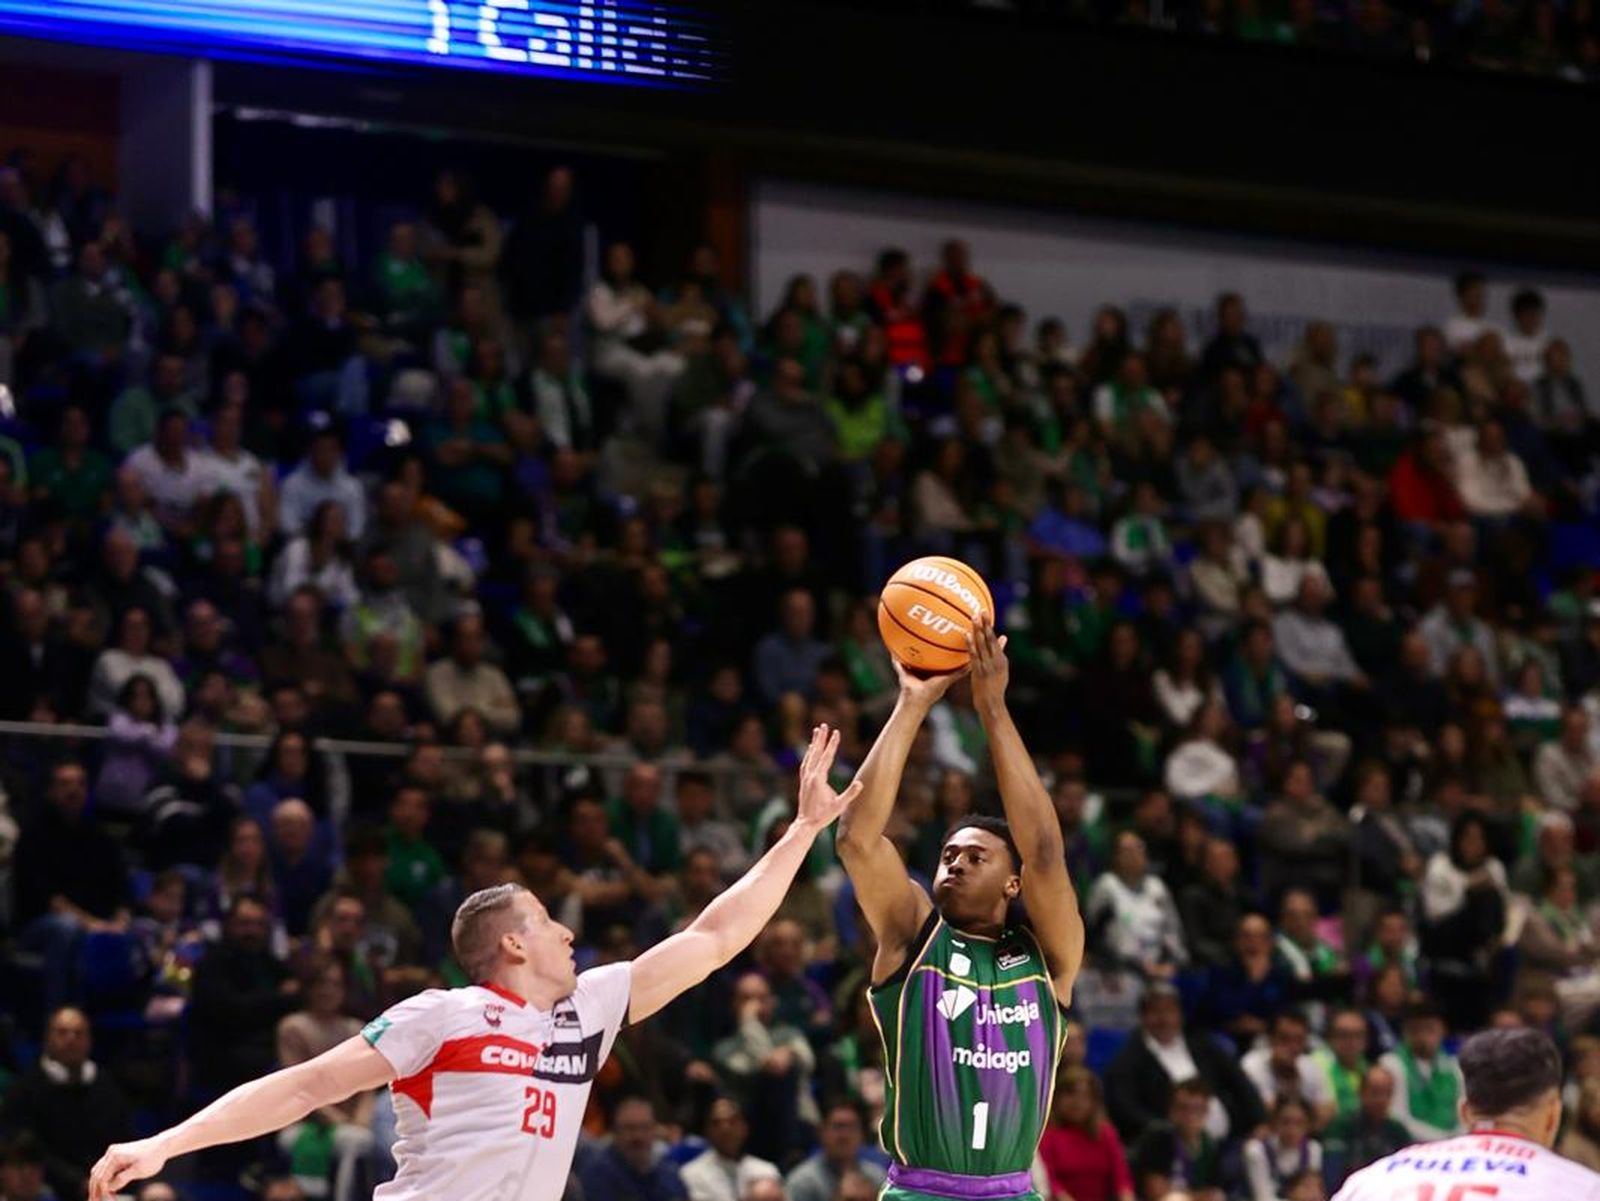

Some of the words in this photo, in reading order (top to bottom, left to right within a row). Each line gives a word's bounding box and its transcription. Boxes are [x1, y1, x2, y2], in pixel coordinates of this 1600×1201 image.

[976, 999, 1040, 1027] Unicaja
[521, 1086, 556, 1139] 29
[971, 1101, 989, 1150] 1
[1386, 1156, 1529, 1177] PULEVA
